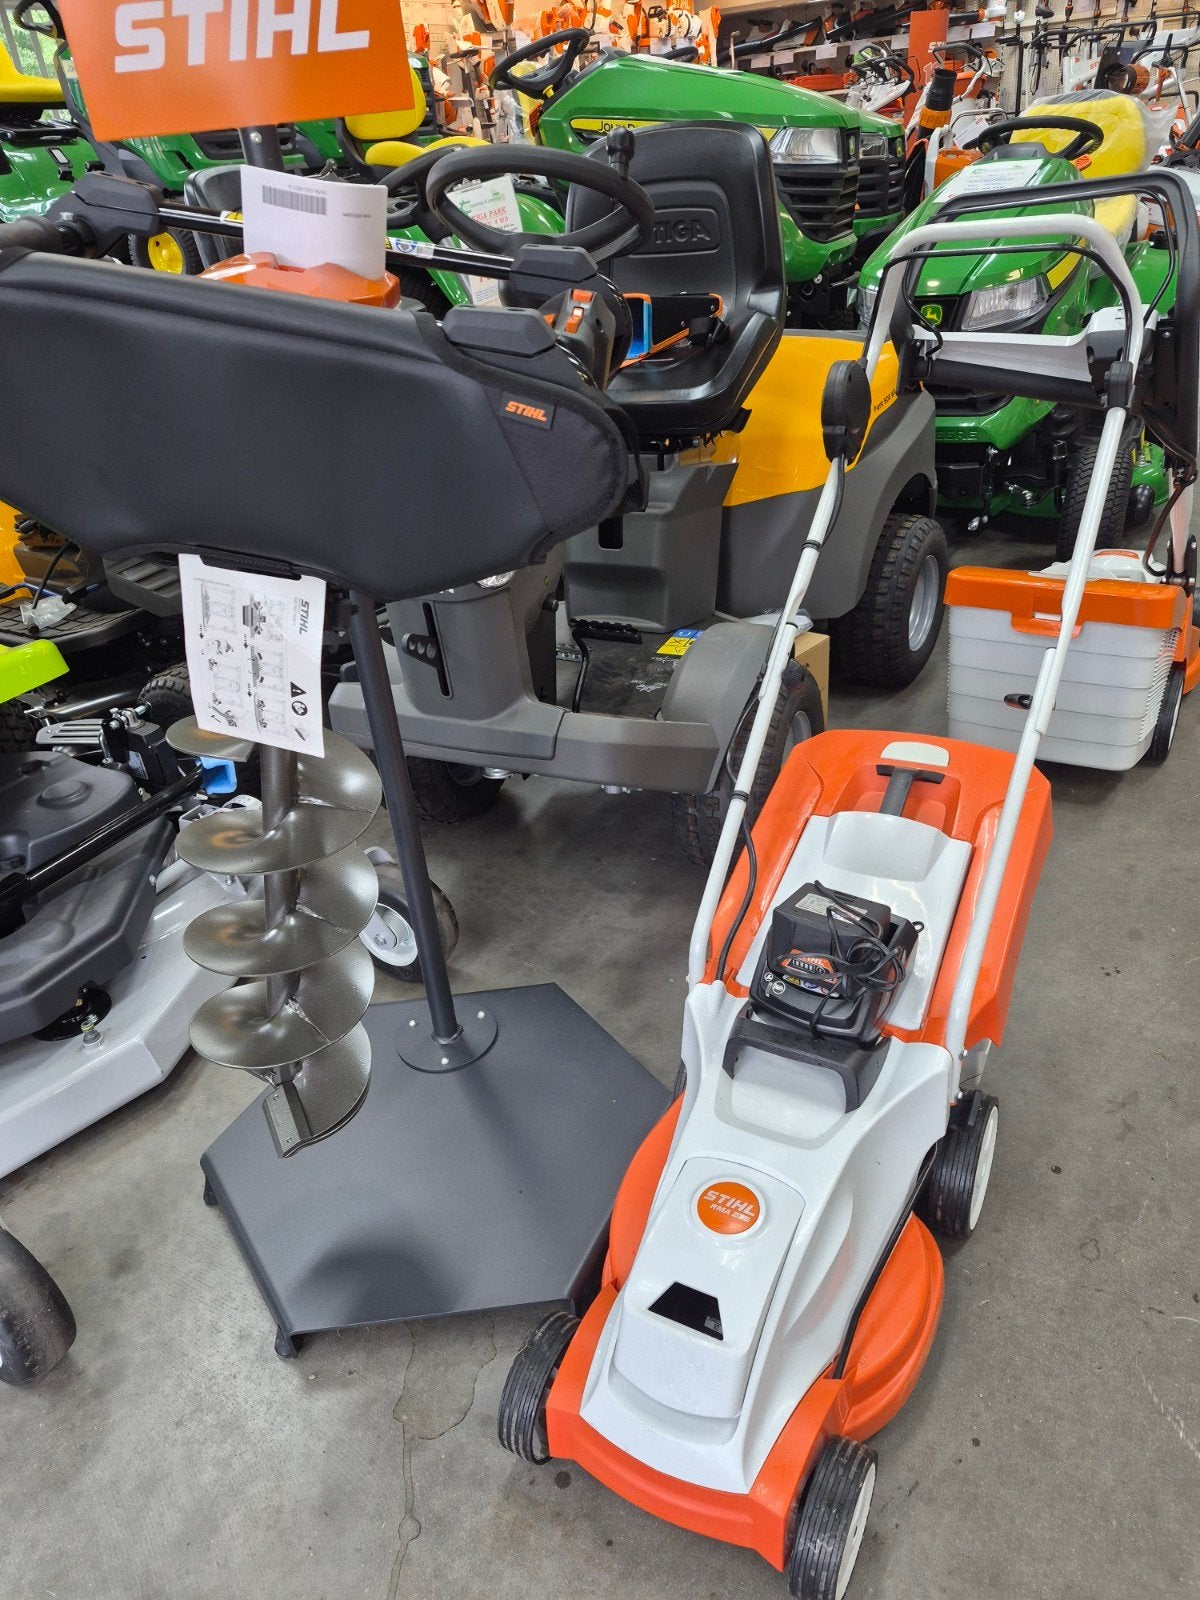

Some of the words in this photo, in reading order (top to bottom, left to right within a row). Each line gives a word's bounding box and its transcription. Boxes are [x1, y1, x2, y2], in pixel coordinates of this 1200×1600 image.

[114, 0, 371, 74] STIHL
[504, 400, 548, 423] STIHL
[298, 599, 310, 635] STIHL
[703, 1189, 756, 1218] STIHL
[709, 1202, 732, 1216] RMA
